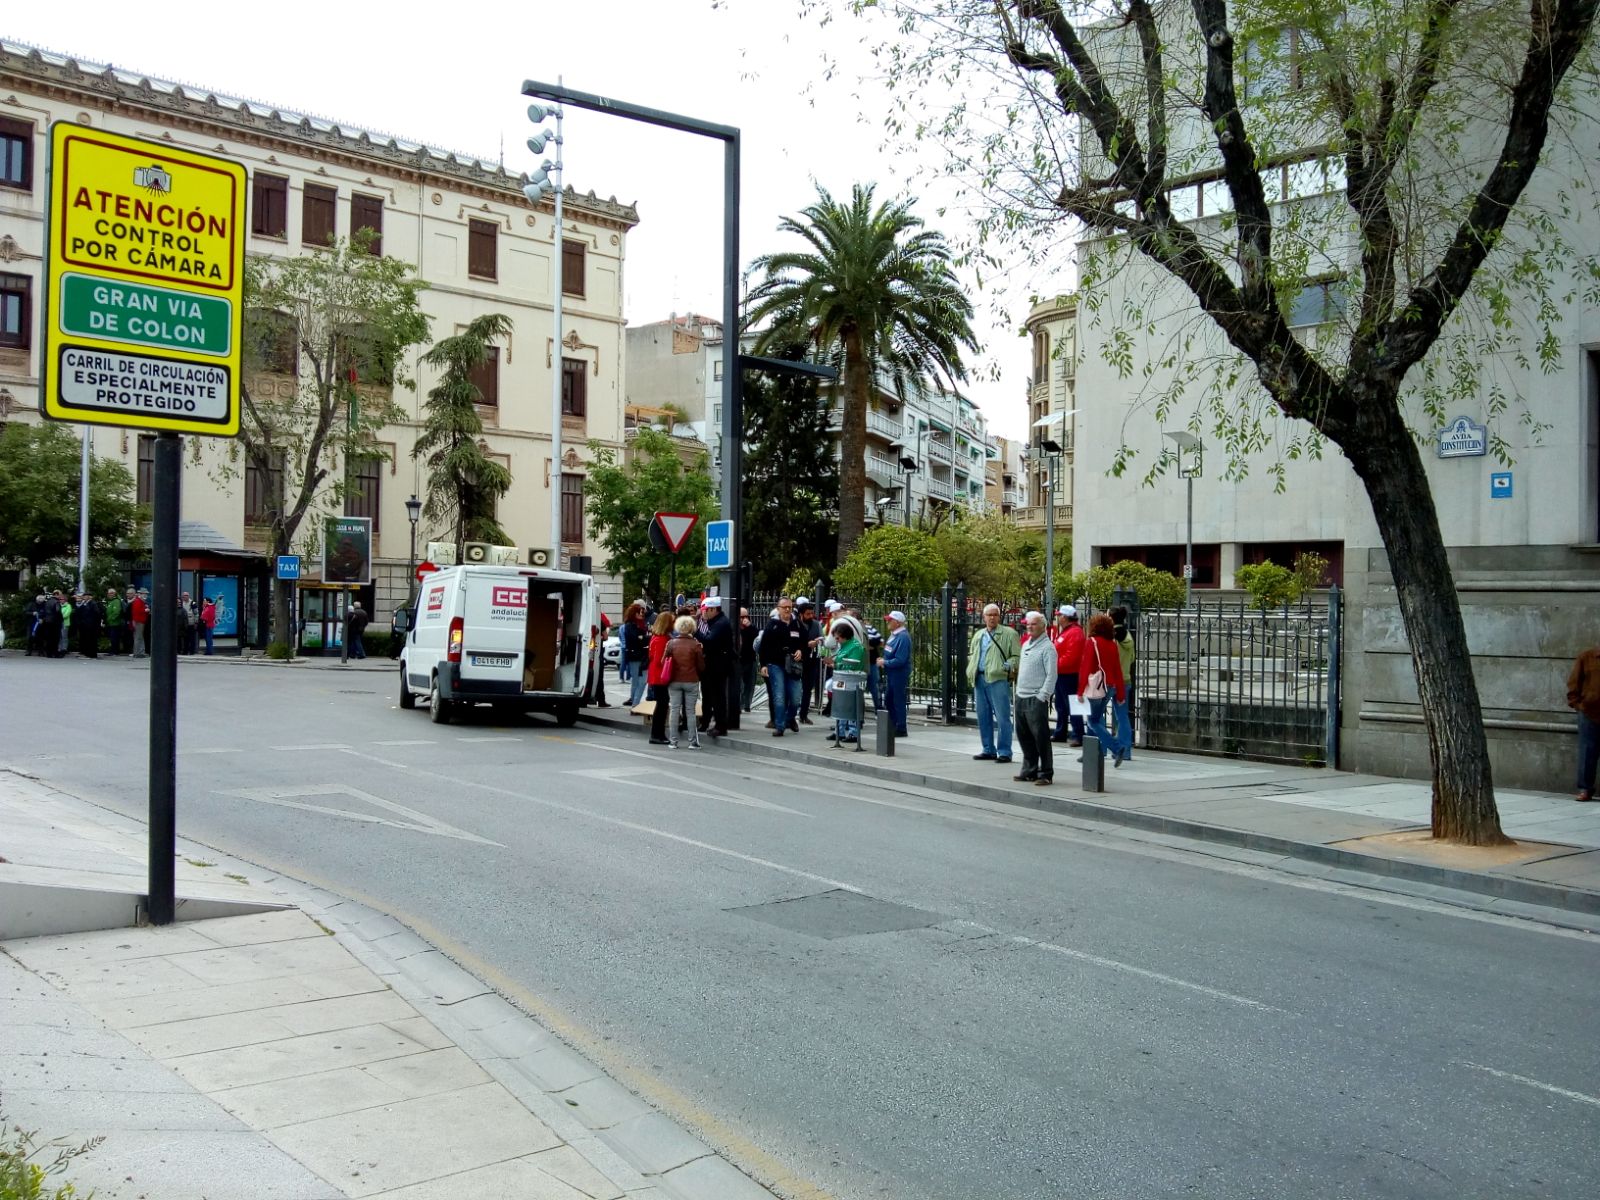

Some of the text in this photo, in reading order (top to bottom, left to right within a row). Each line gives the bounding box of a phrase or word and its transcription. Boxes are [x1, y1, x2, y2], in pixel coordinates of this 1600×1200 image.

[73, 187, 226, 239] ATENCIÓN
[95, 219, 203, 255] CONTROL
[72, 237, 222, 280] POR CÁMARA
[94, 286, 203, 320] GRAN VIA
[90, 311, 206, 344] DE COLON
[66, 353, 224, 385] CARRIL DE CIRCULACIÓN
[74, 371, 216, 399] ESPECIALMENTE
[96, 390, 196, 412] PROTEGIDO
[709, 537, 729, 552] TAXI
[279, 563, 298, 571] TAXI
